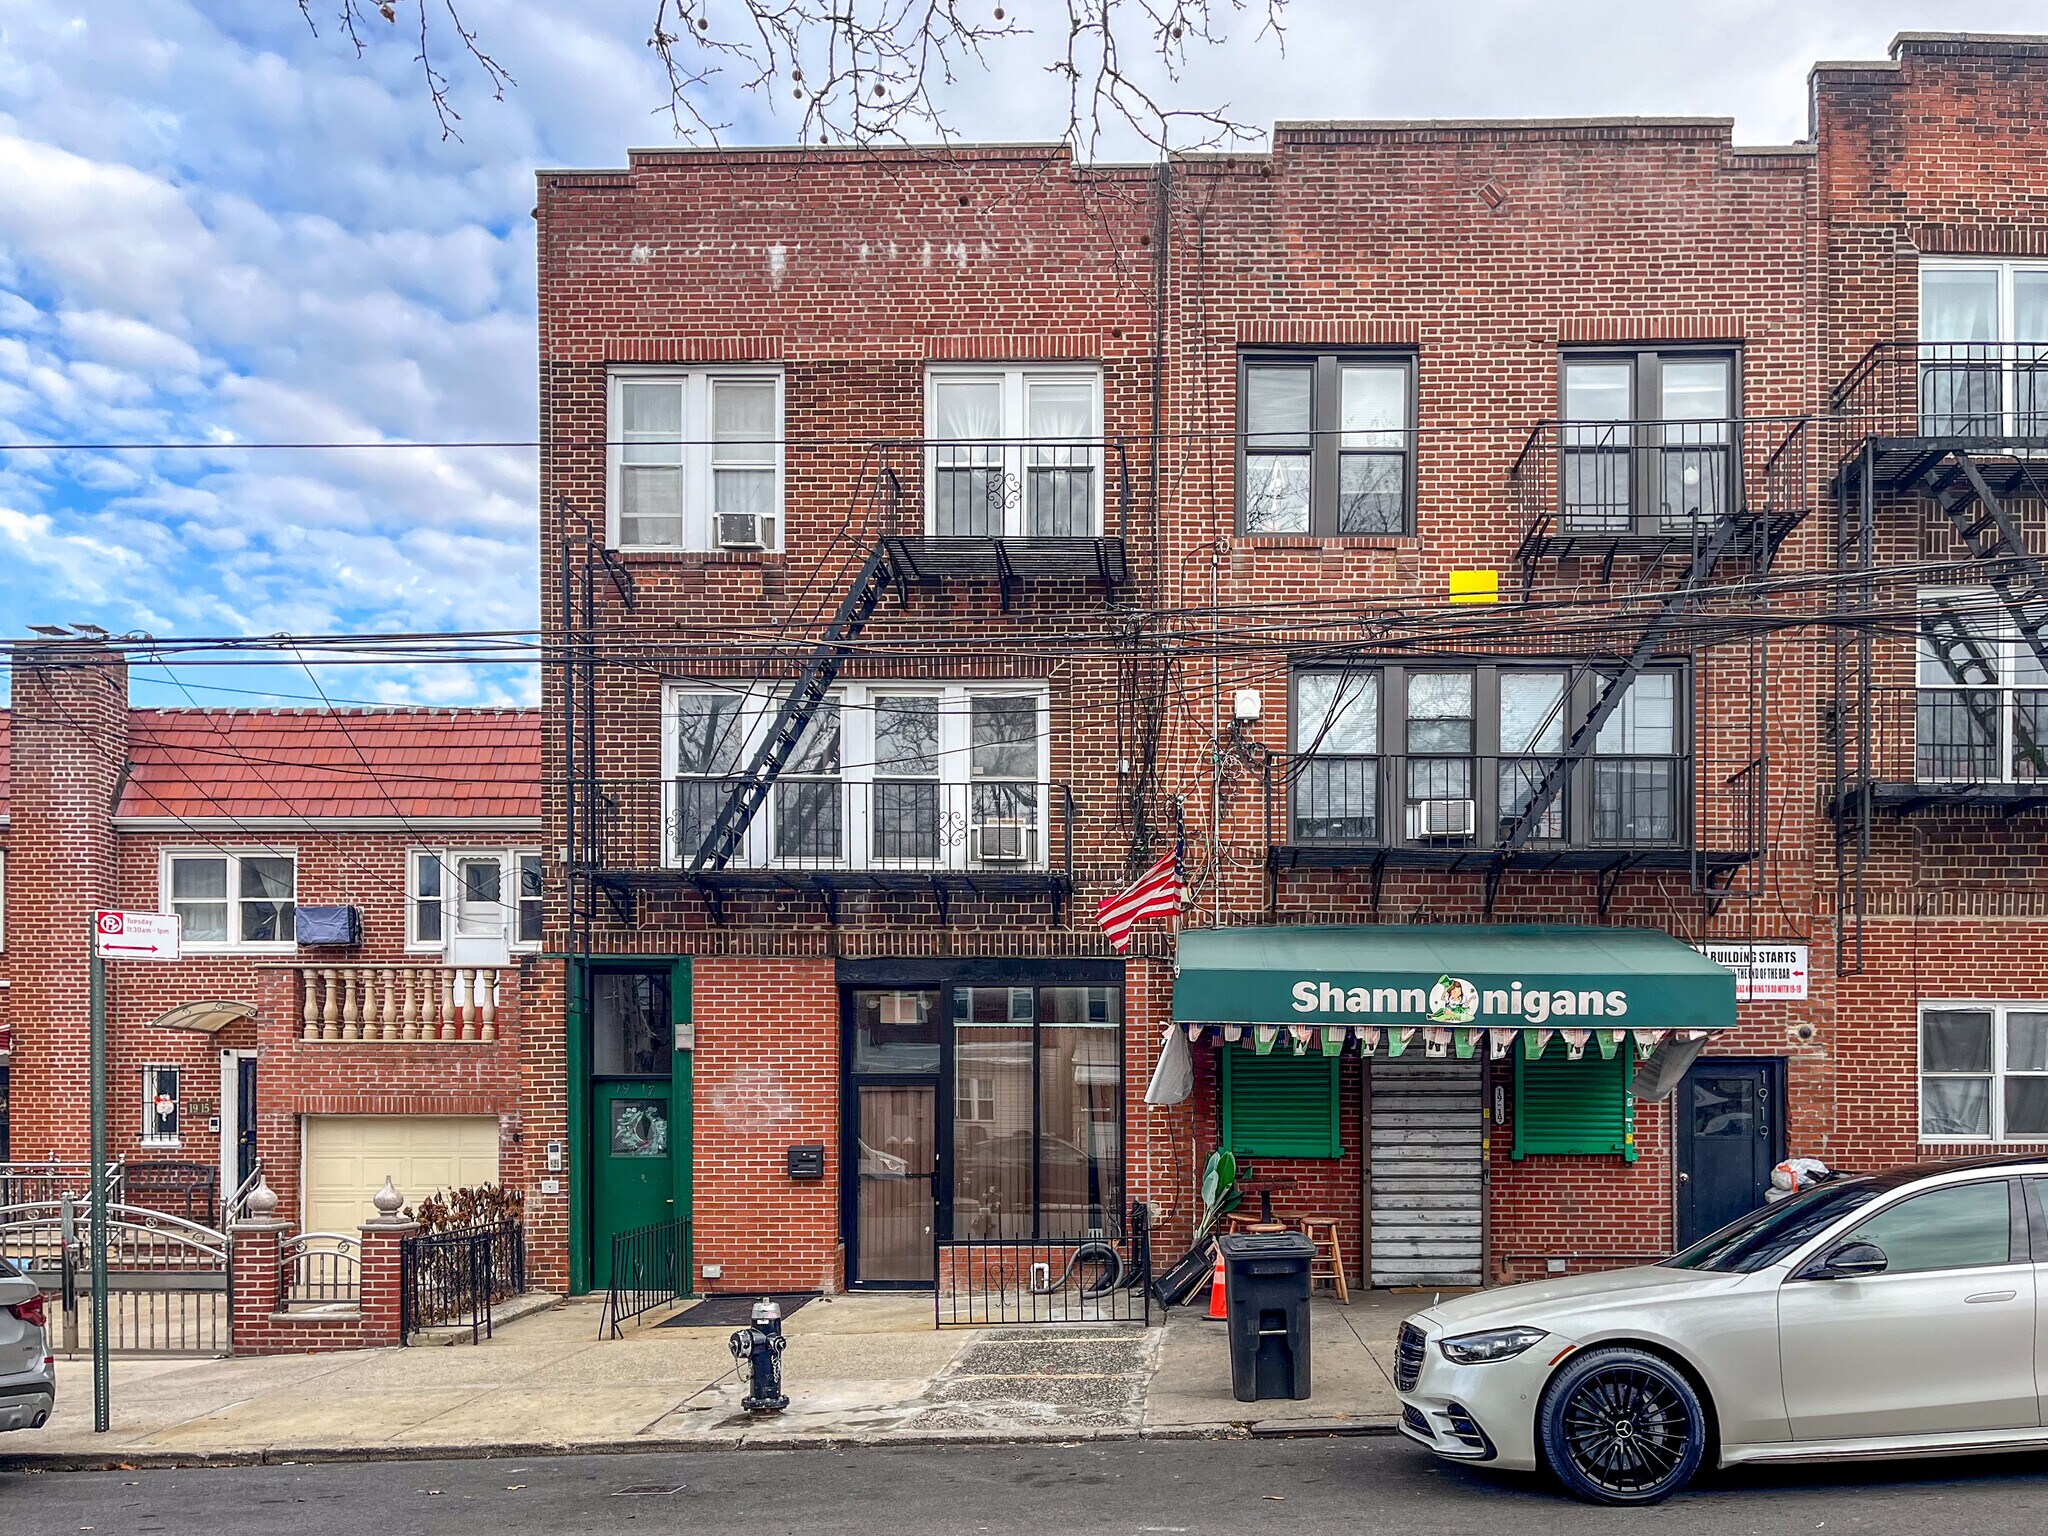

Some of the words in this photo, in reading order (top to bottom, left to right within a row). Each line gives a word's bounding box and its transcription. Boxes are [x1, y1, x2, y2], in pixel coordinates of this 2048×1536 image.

[127, 917, 153, 926] Tuesday
[126, 926, 151, 934] 11:30am
[1710, 951, 1756, 963] BUILDING
[1759, 951, 1797, 963] STARTS
[1737, 967, 1748, 979] THE
[1760, 967, 1767, 979] OF
[1767, 967, 1778, 979] THE
[1778, 967, 1790, 979] BAR
